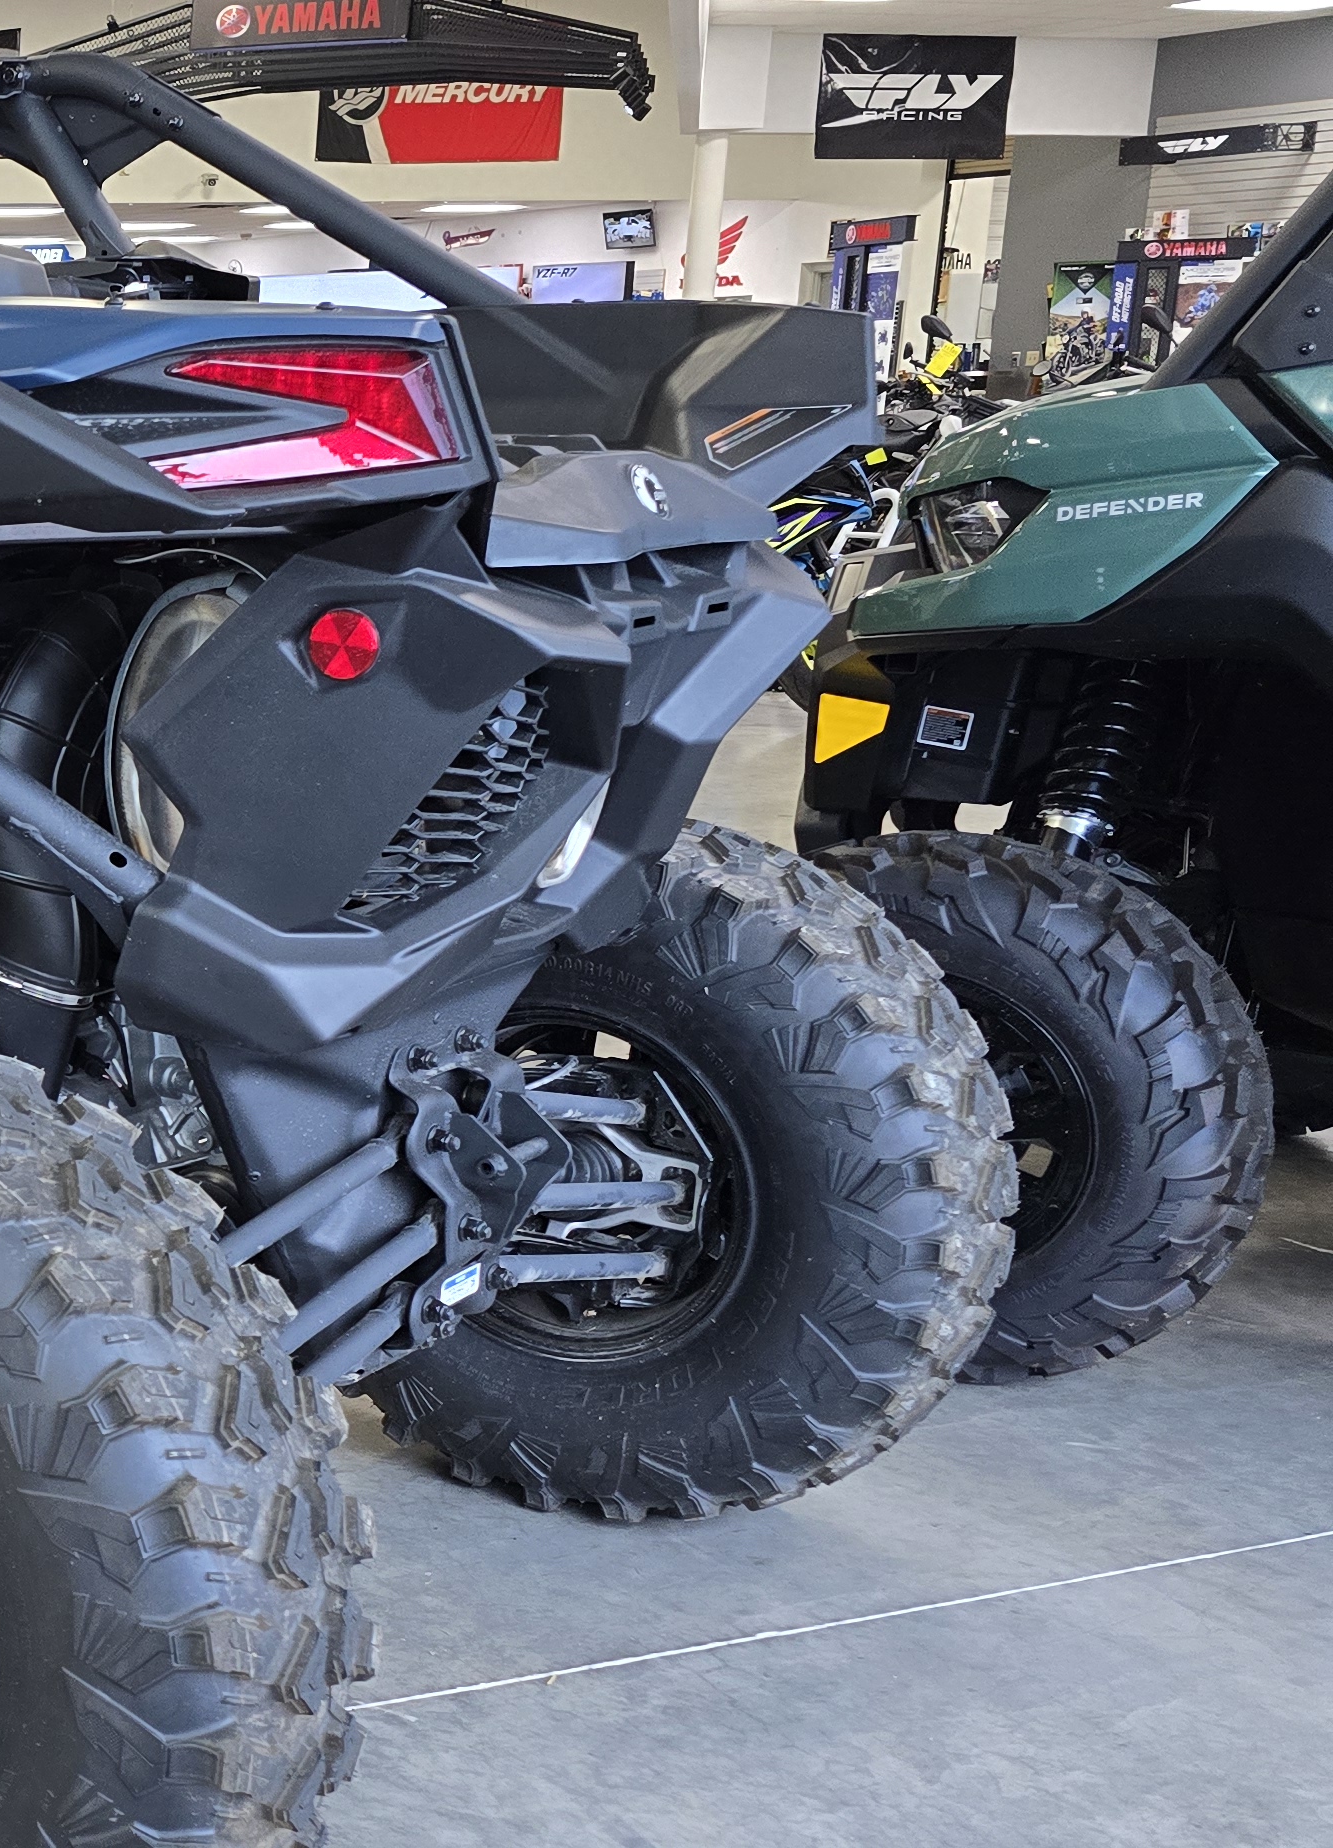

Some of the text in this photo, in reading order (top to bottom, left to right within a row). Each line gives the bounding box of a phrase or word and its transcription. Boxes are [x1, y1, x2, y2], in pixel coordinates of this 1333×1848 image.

[254, 0, 380, 35] YAMAHA
[394, 82, 548, 103] MERCURY
[829, 74, 1004, 109] FLY
[862, 111, 963, 121] RACING
[1163, 241, 1227, 257] YAMAHA
[536, 267, 578, 279] YZF-R7
[1056, 492, 1204, 522] DEFENDER
